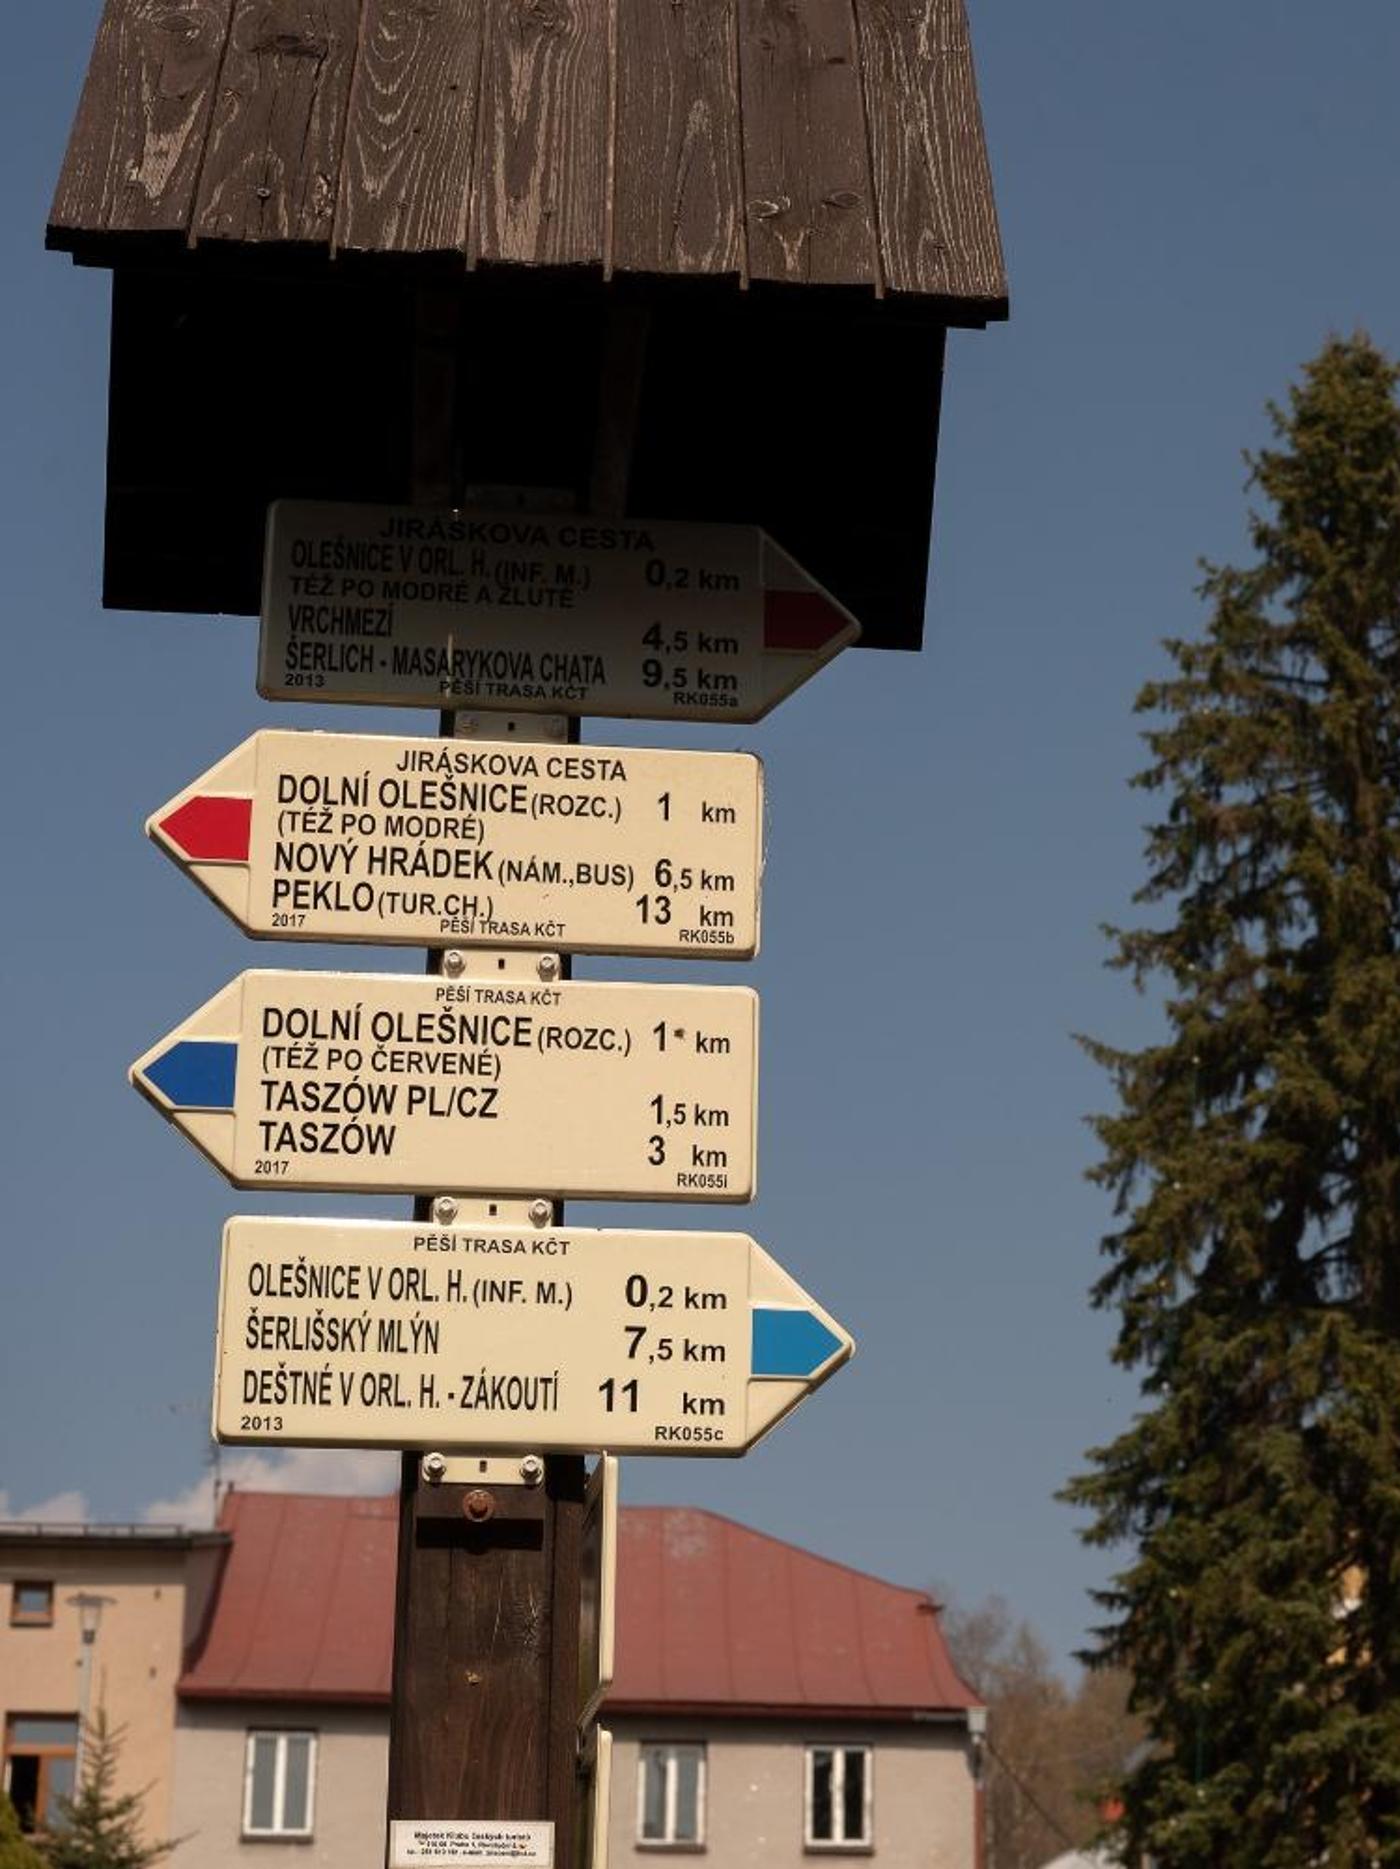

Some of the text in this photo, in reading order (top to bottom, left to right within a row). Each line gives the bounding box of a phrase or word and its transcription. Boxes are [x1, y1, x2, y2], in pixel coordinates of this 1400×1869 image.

[378, 514, 657, 553] JIRÁSKOVA CESTA
[290, 533, 395, 573] OLEŠNICE
[398, 543, 415, 574] V
[417, 543, 465, 577] ORL.
[553, 565, 592, 592] M.)
[644, 557, 690, 592] 0,2
[698, 567, 740, 592] km
[288, 571, 577, 610] TÉŽ PO MODRÉ A ŽLUTÉ
[284, 600, 739, 656] VRCHMEZÍ 4,5 km
[284, 672, 325, 688] 2013
[285, 633, 375, 673] ŠERLICH
[391, 644, 535, 683] MASARYKOVA
[538, 652, 607, 685] CHATA
[641, 658, 688, 691] 9,5
[697, 667, 738, 691] km
[438, 677, 588, 700] PĚŠÍ TRASA KČT
[396, 746, 627, 782] JIRÁSKOVA CESTA
[277, 770, 371, 808] DOLNÍ
[657, 791, 670, 822] 1
[701, 800, 736, 824] km
[277, 806, 485, 845] (TÉŽ PO MODRÉ)
[273, 836, 359, 875] NOVÝ
[367, 839, 494, 881] HRÁDEK
[654, 858, 693, 894] 6,5
[700, 868, 735, 892] km
[271, 912, 306, 928] 2017
[272, 878, 375, 912] PEKLO
[635, 893, 672, 925] 13
[699, 904, 734, 928] km
[440, 916, 566, 938] PĚŠÍ TRASA KČT
[679, 928, 735, 945] RK055b
[435, 985, 562, 1006] PĚŠÍ TRASA KČT
[262, 1002, 363, 1041] DOLNÍ
[695, 1030, 731, 1054] km
[262, 1041, 502, 1077] (TÉŽ PO ČERVENÉ)
[260, 1074, 729, 1129] TASZÓW PL/CZ 1,5 km
[258, 1115, 728, 1168] TASZÓW 3 km
[254, 1159, 290, 1175] 2017
[413, 1233, 571, 1256] PĚŠÍ TRASA KČT
[247, 1255, 362, 1300] OLEŠNICE
[367, 1265, 384, 1301] V
[387, 1266, 440, 1303] ORL.
[446, 1268, 468, 1303] H.
[536, 1280, 573, 1312] M.)
[625, 1274, 674, 1313] 0,2
[684, 1285, 727, 1310] km
[245, 1308, 726, 1365] ŠERLIŠSKÝ MLÝN 7,5 km
[242, 1362, 334, 1406] DEŠTNÉ
[339, 1374, 355, 1407] V
[359, 1374, 412, 1409] ORL.
[419, 1373, 440, 1409] H.
[459, 1366, 559, 1412] ZÁKOUTÍ
[598, 1377, 638, 1413] 11
[682, 1391, 726, 1417] km
[240, 1415, 283, 1431] 2013
[654, 1425, 724, 1442] RK055c
